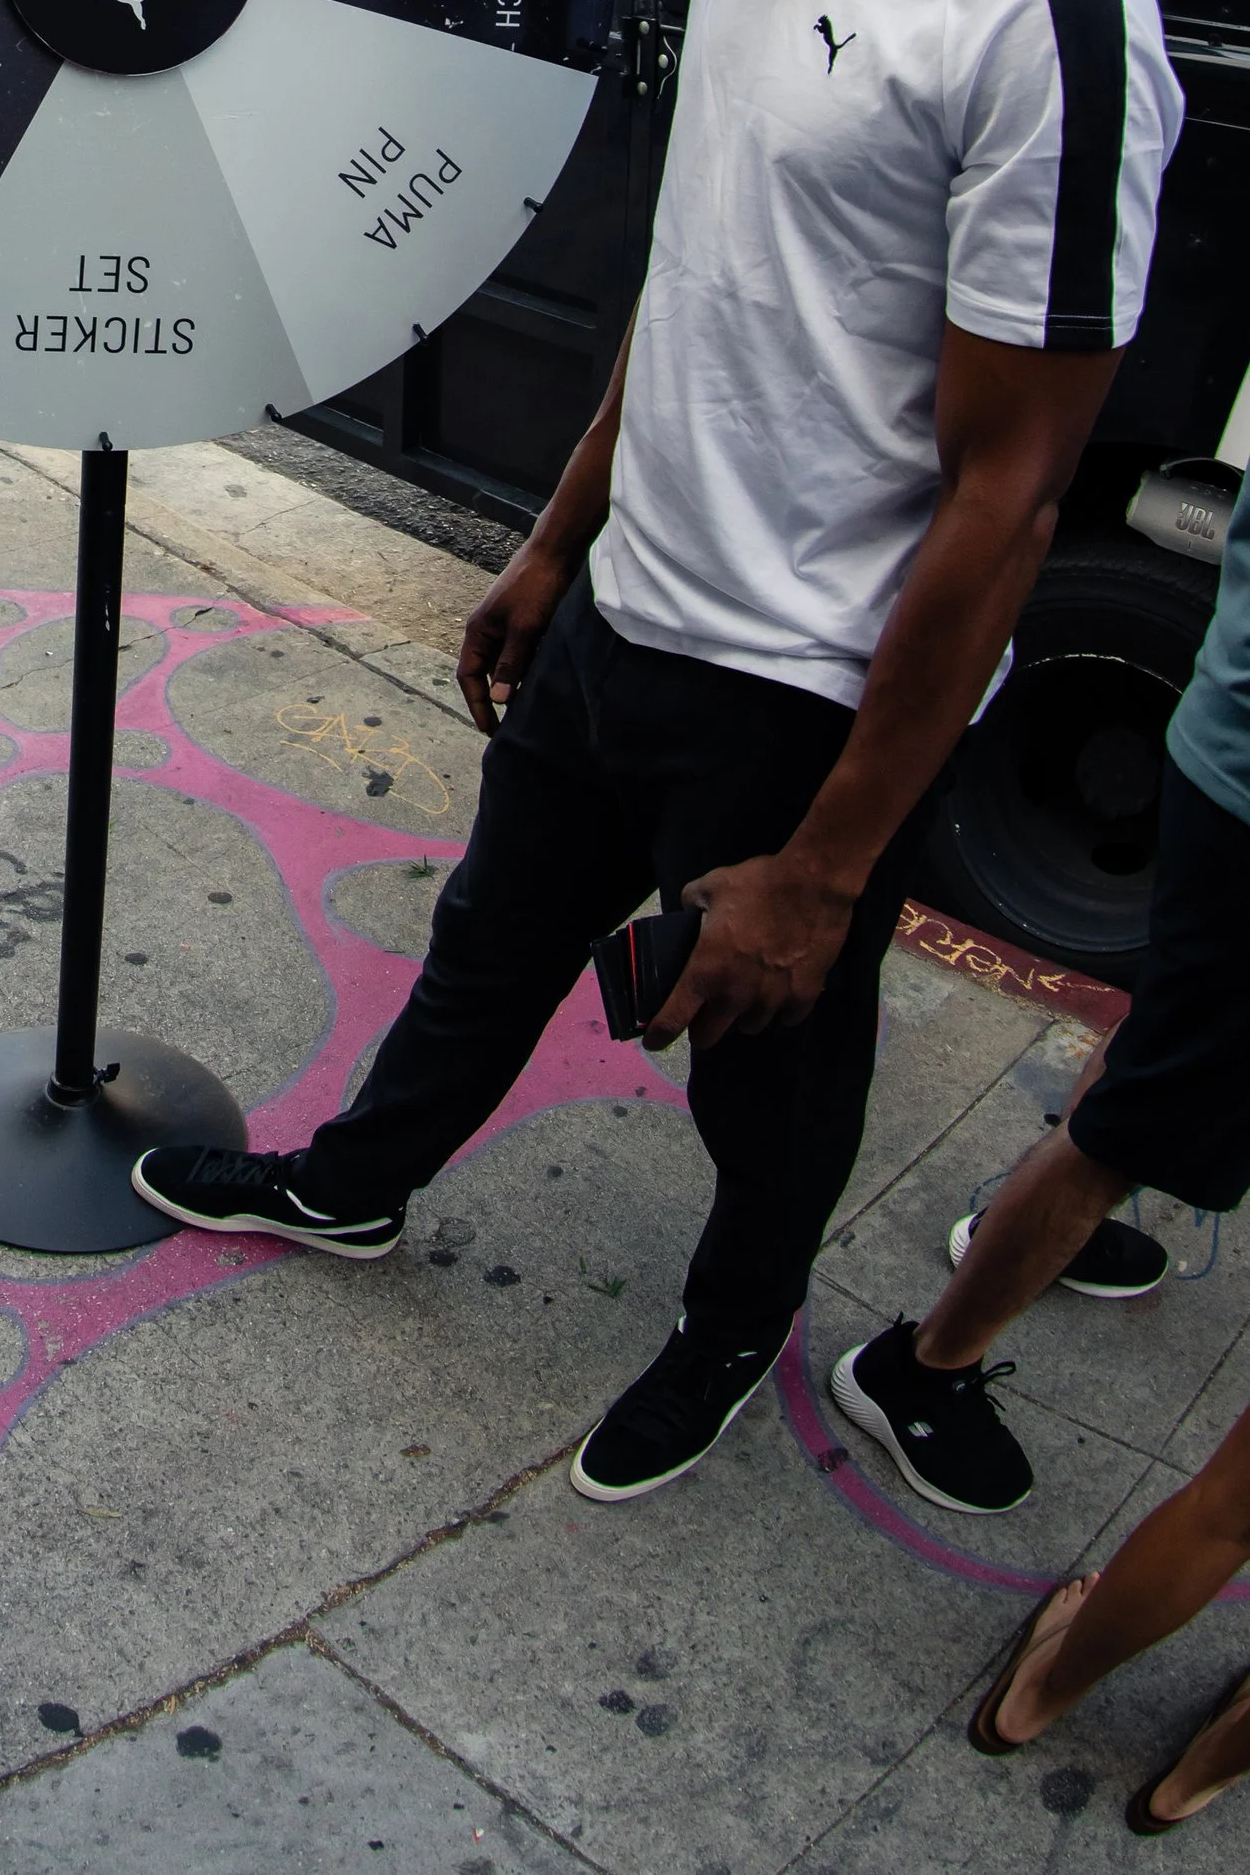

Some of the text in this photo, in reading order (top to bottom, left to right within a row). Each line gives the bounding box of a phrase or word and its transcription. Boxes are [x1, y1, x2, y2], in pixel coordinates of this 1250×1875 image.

[338, 126, 406, 199] PIN
[363, 148, 462, 249] PUMA
[68, 254, 151, 294] SET
[15, 314, 196, 355] STICKER
[1175, 501, 1215, 541] JBL
